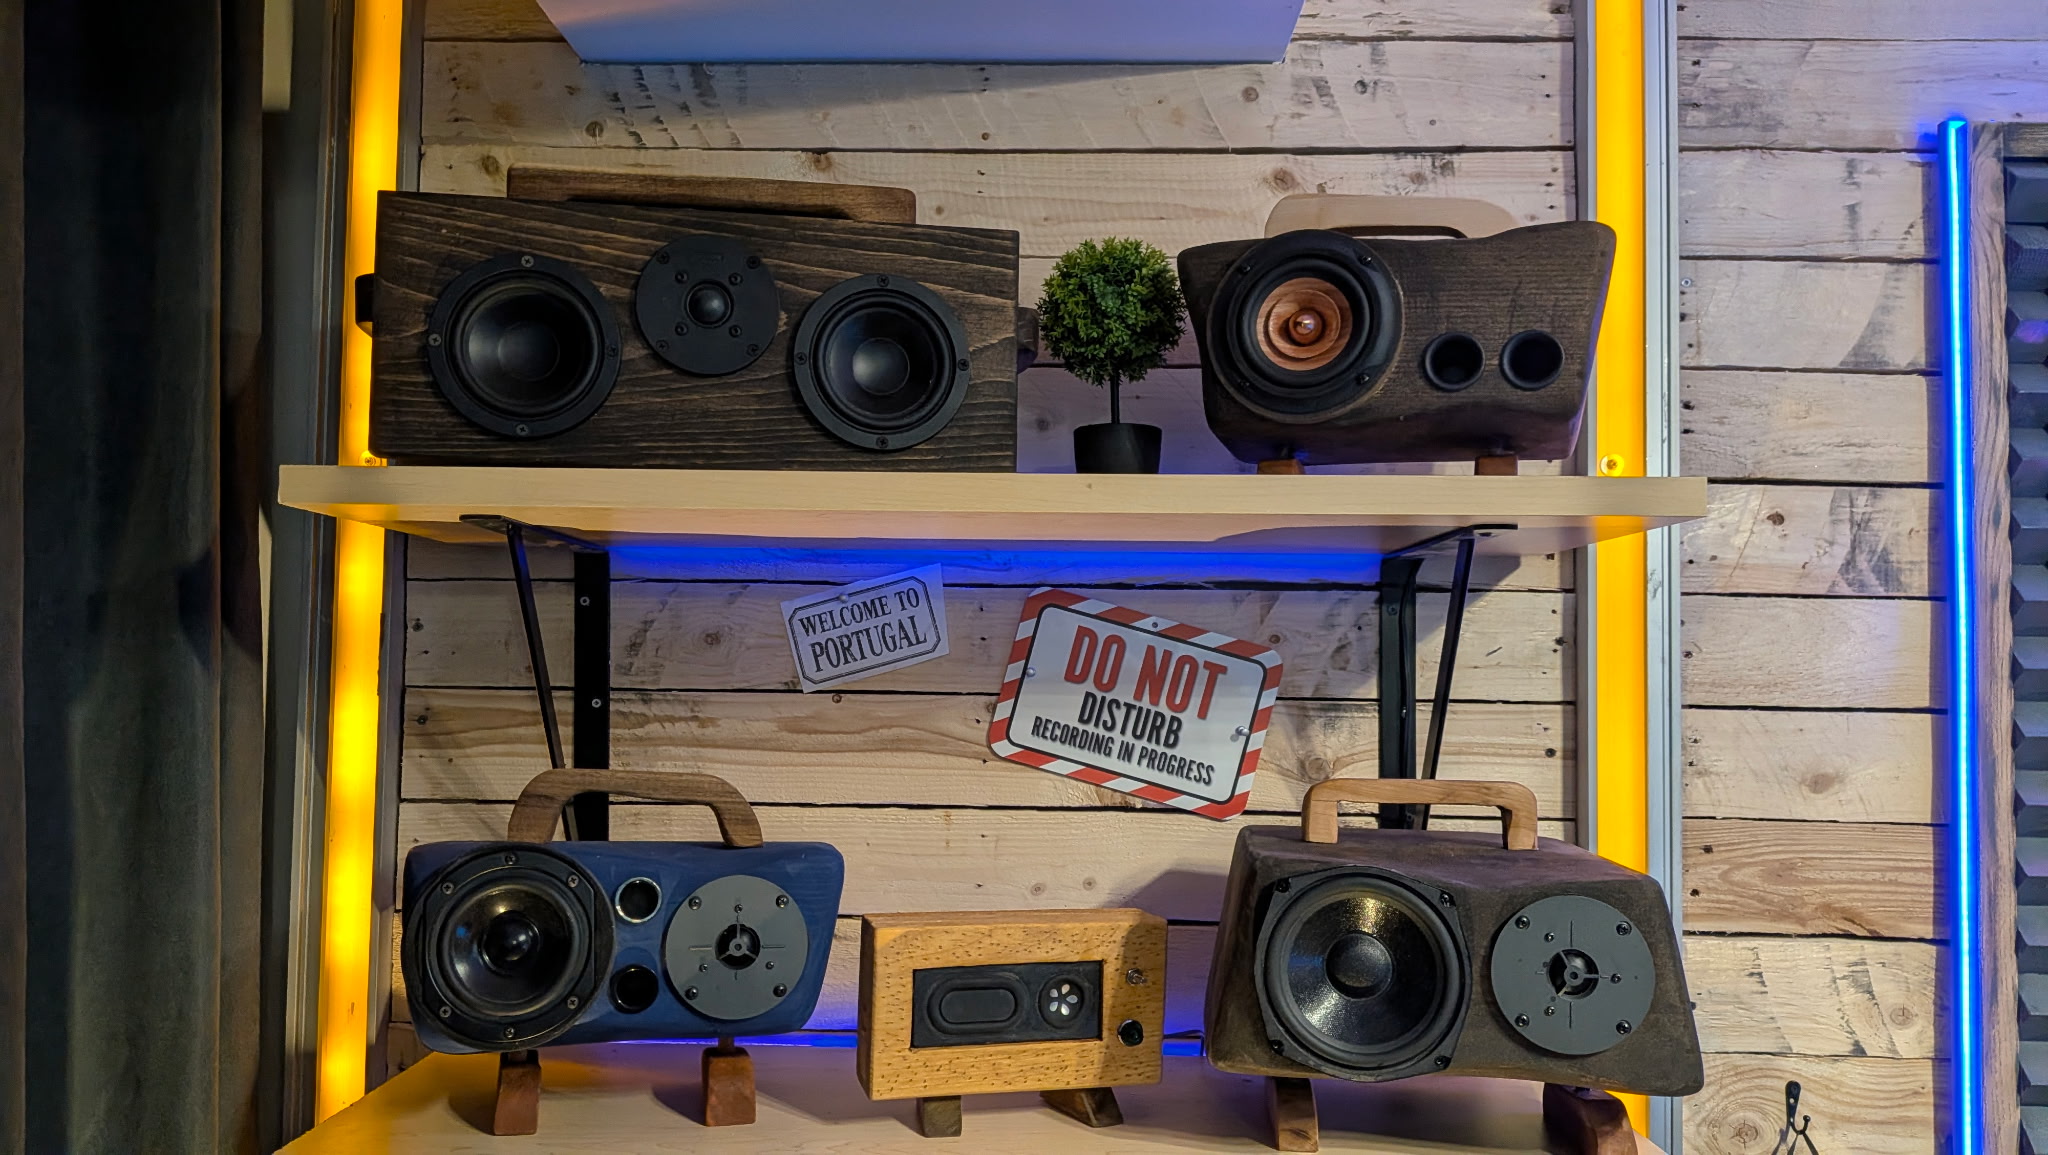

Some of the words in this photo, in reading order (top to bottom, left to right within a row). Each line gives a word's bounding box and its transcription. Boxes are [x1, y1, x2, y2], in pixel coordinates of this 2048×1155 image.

[798, 596, 891, 637] WELCOME
[894, 587, 920, 612] TO
[808, 615, 927, 673] PORTUGAL
[1064, 625, 1127, 693] DO
[1133, 645, 1228, 720] NOT
[1077, 691, 1183, 749] DISTURB
[1031, 716, 1115, 757] RECORDING
[1117, 740, 1136, 764] IN
[1137, 746, 1215, 786] PROGRESS
